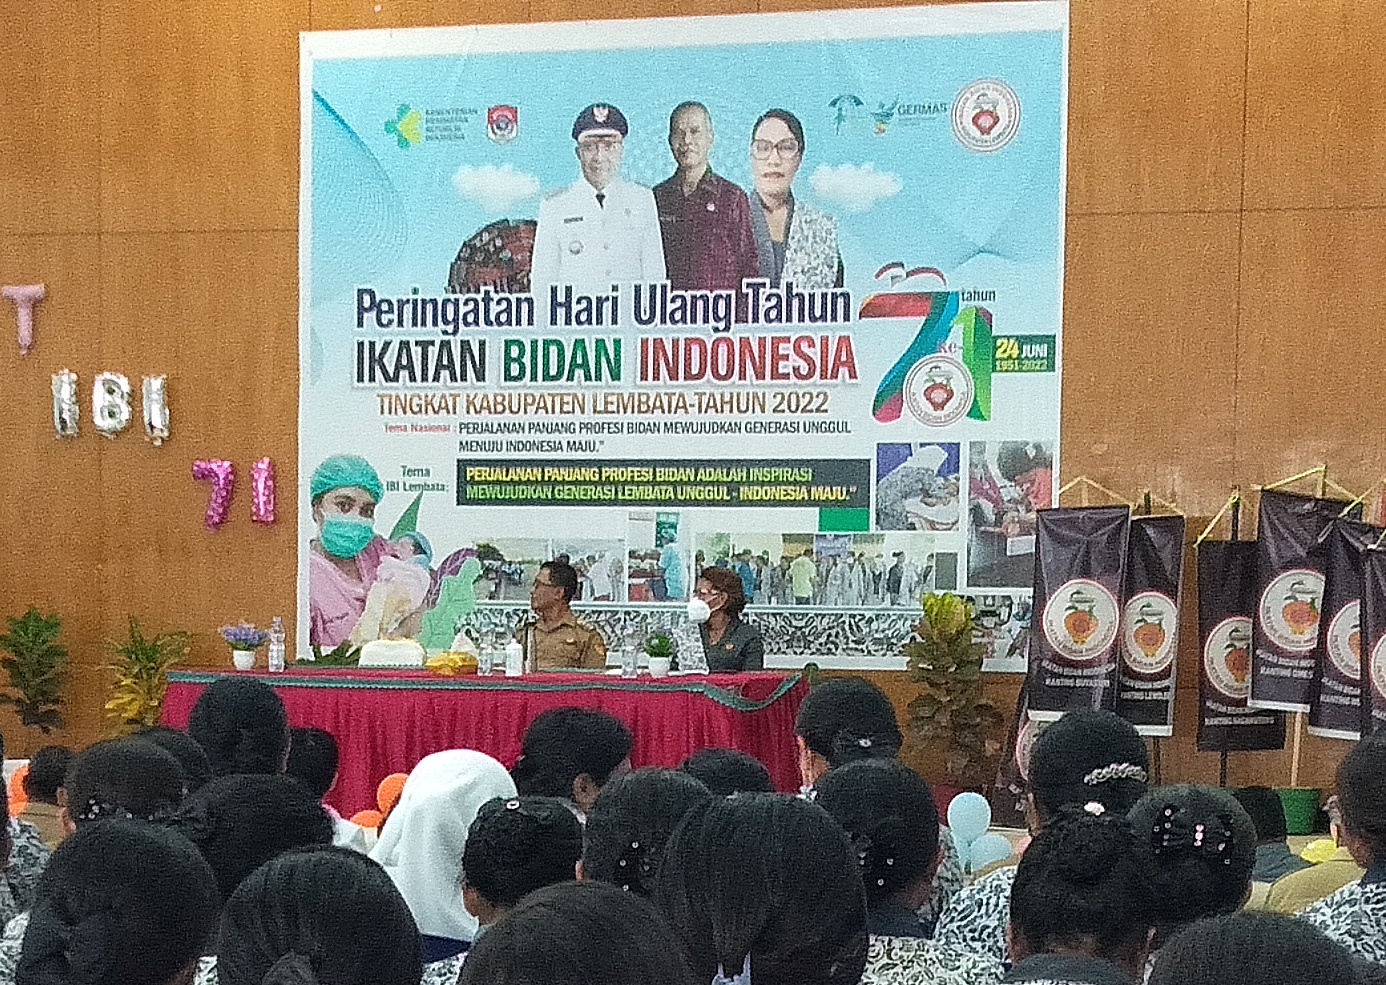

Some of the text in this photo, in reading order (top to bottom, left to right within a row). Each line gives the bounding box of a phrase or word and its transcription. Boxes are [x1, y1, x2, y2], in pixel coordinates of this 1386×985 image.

[897, 102, 948, 116] GERMAS
[962, 288, 996, 302] tahun
[356, 282, 851, 336] Peringatan Hari Ulang Tahun
[995, 338, 1048, 359] 24 JUNI
[356, 335, 858, 384] IKATAN BIDAN INDONESIA
[376, 391, 830, 416] TINGKAT KABUPATEN LEMBATA-TAHUN 2022
[458, 422, 525, 435] PERJALANAN
[528, 422, 576, 435] PANJANG
[579, 421, 624, 435] PROFESI
[627, 421, 661, 434] BIDAN
[663, 421, 742, 434] MEWUJUDKAN
[744, 421, 800, 434] GENERASI
[803, 420, 851, 434] UNGGUL
[458, 440, 503, 453] MENUJU
[505, 440, 564, 453] INDONESIA
[400, 465, 431, 478] Tema
[466, 467, 813, 482] PERJALANAN PANJANG PROFESI BIDAN ADALAH INSPIRASI
[192, 457, 275, 530] 71
[386, 480, 449, 493] IBI Lembata:
[466, 485, 551, 500] MEWUJUDKAN
[554, 485, 616, 500] GENERASI
[618, 485, 677, 501] LEMBATA
[679, 485, 730, 501] UNGGUL
[740, 485, 808, 501] INDONESIA
